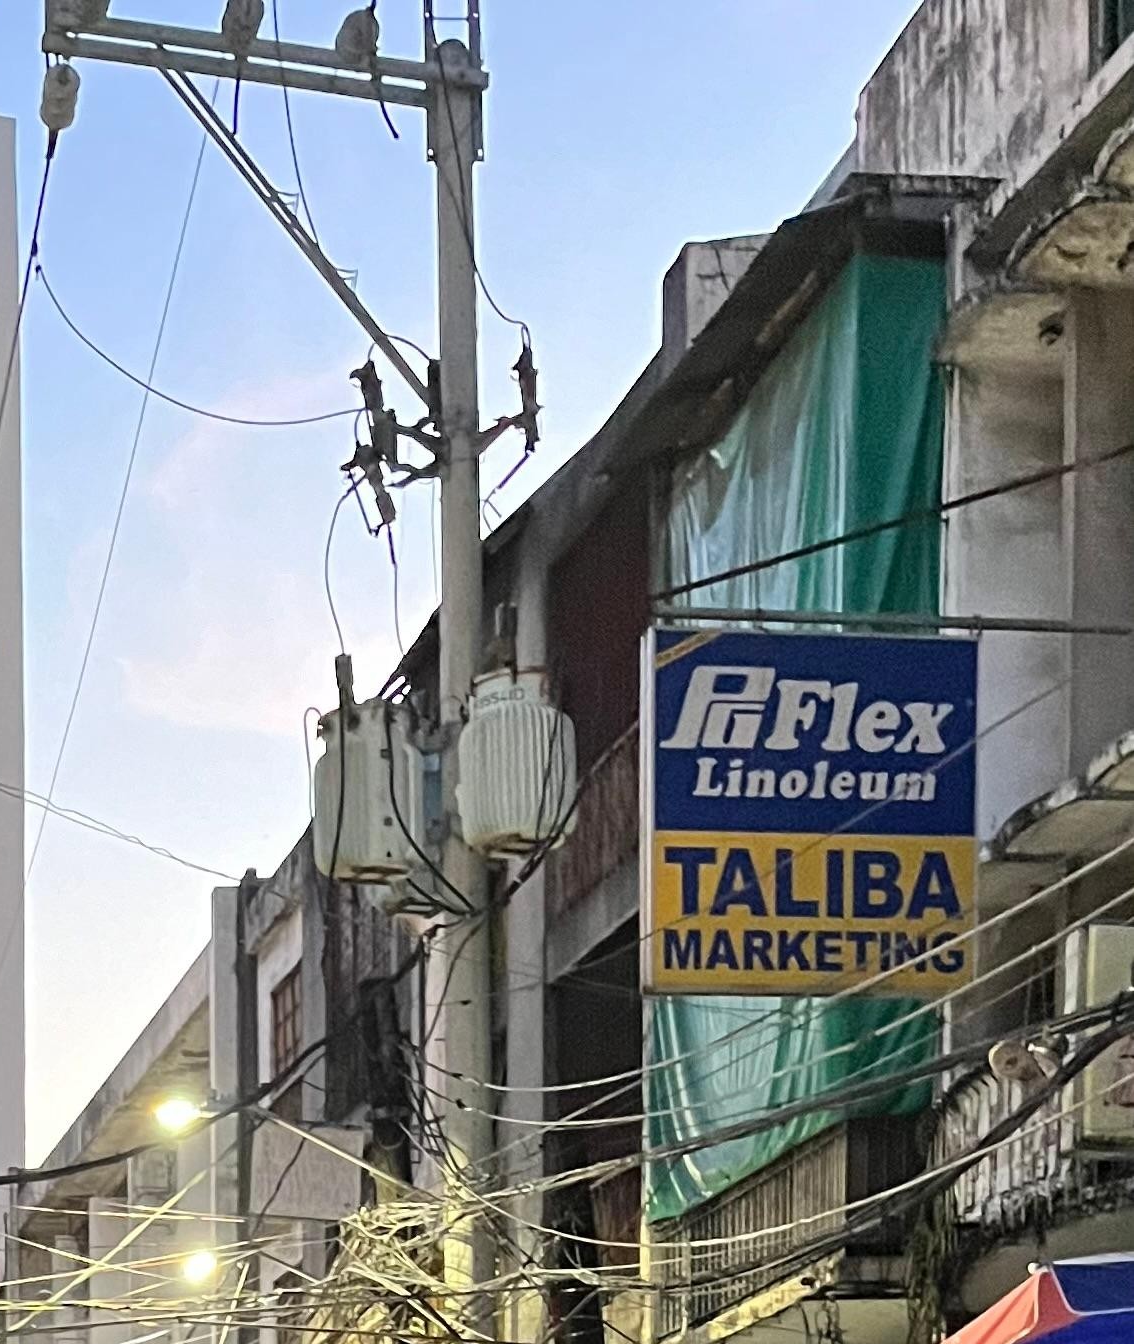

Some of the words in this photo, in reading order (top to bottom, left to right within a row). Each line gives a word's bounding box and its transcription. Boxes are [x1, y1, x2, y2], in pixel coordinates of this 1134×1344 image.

[692, 757, 936, 801] Linoleum
[664, 846, 963, 921] TALIBA
[662, 929, 965, 974] MARKETING
